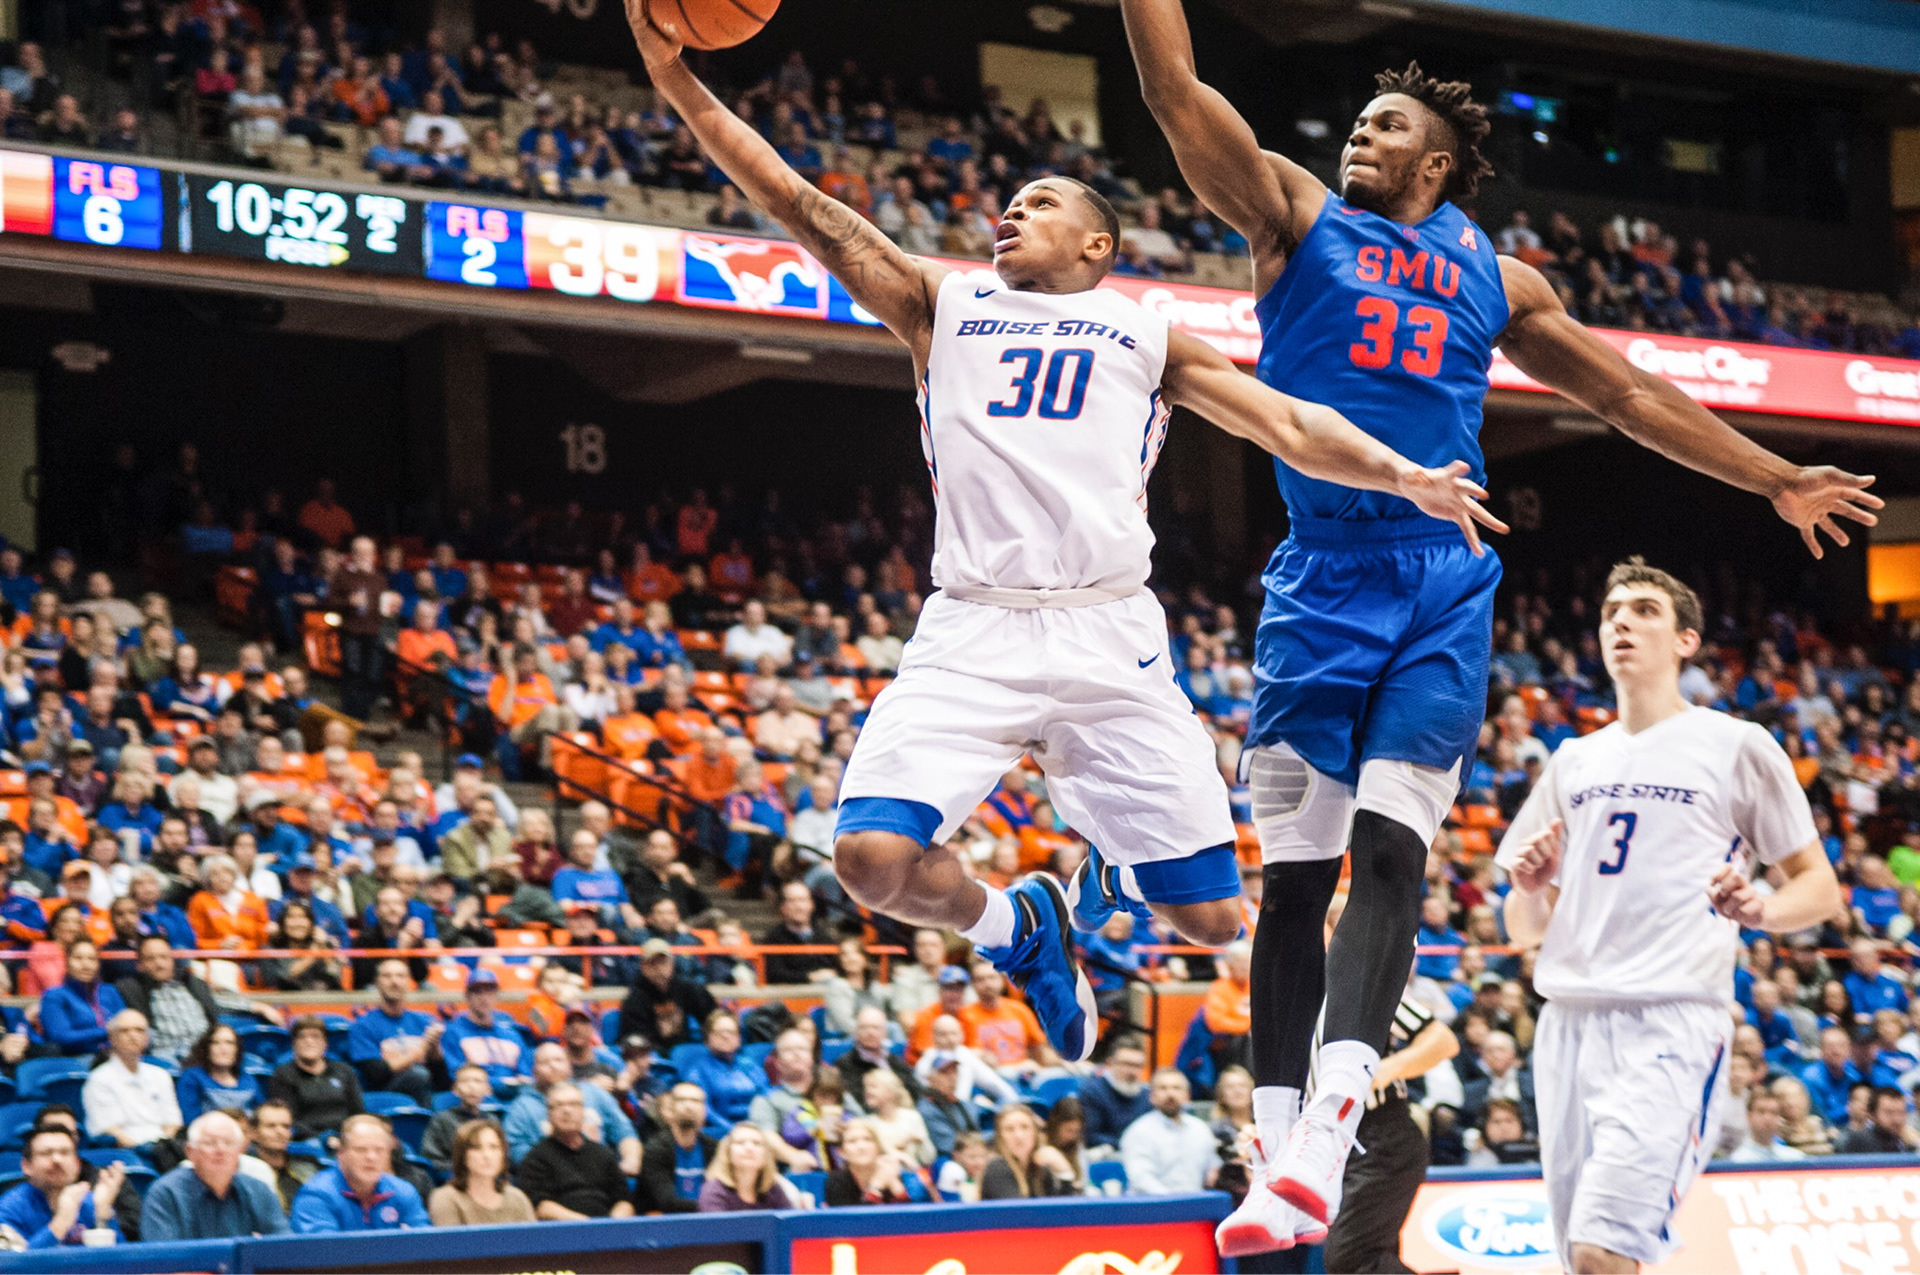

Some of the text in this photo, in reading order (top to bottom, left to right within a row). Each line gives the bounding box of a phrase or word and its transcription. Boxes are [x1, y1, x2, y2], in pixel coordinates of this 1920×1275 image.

[68, 161, 140, 200] FLS
[83, 195, 125, 245] 6
[207, 180, 349, 245] 10:52
[366, 217, 398, 253] 2
[446, 205, 511, 242] FLS
[461, 237, 498, 286] 2
[548, 220, 659, 302] 39
[1355, 246, 1462, 298] SMU
[956, 319, 1137, 350] BOISE STATE
[1349, 295, 1450, 378] 33
[986, 347, 1096, 420] 30
[559, 422, 606, 473] 18
[1628, 784, 1699, 805] STATE
[1597, 810, 1638, 876] 3
[1711, 1178, 1810, 1225] THE
